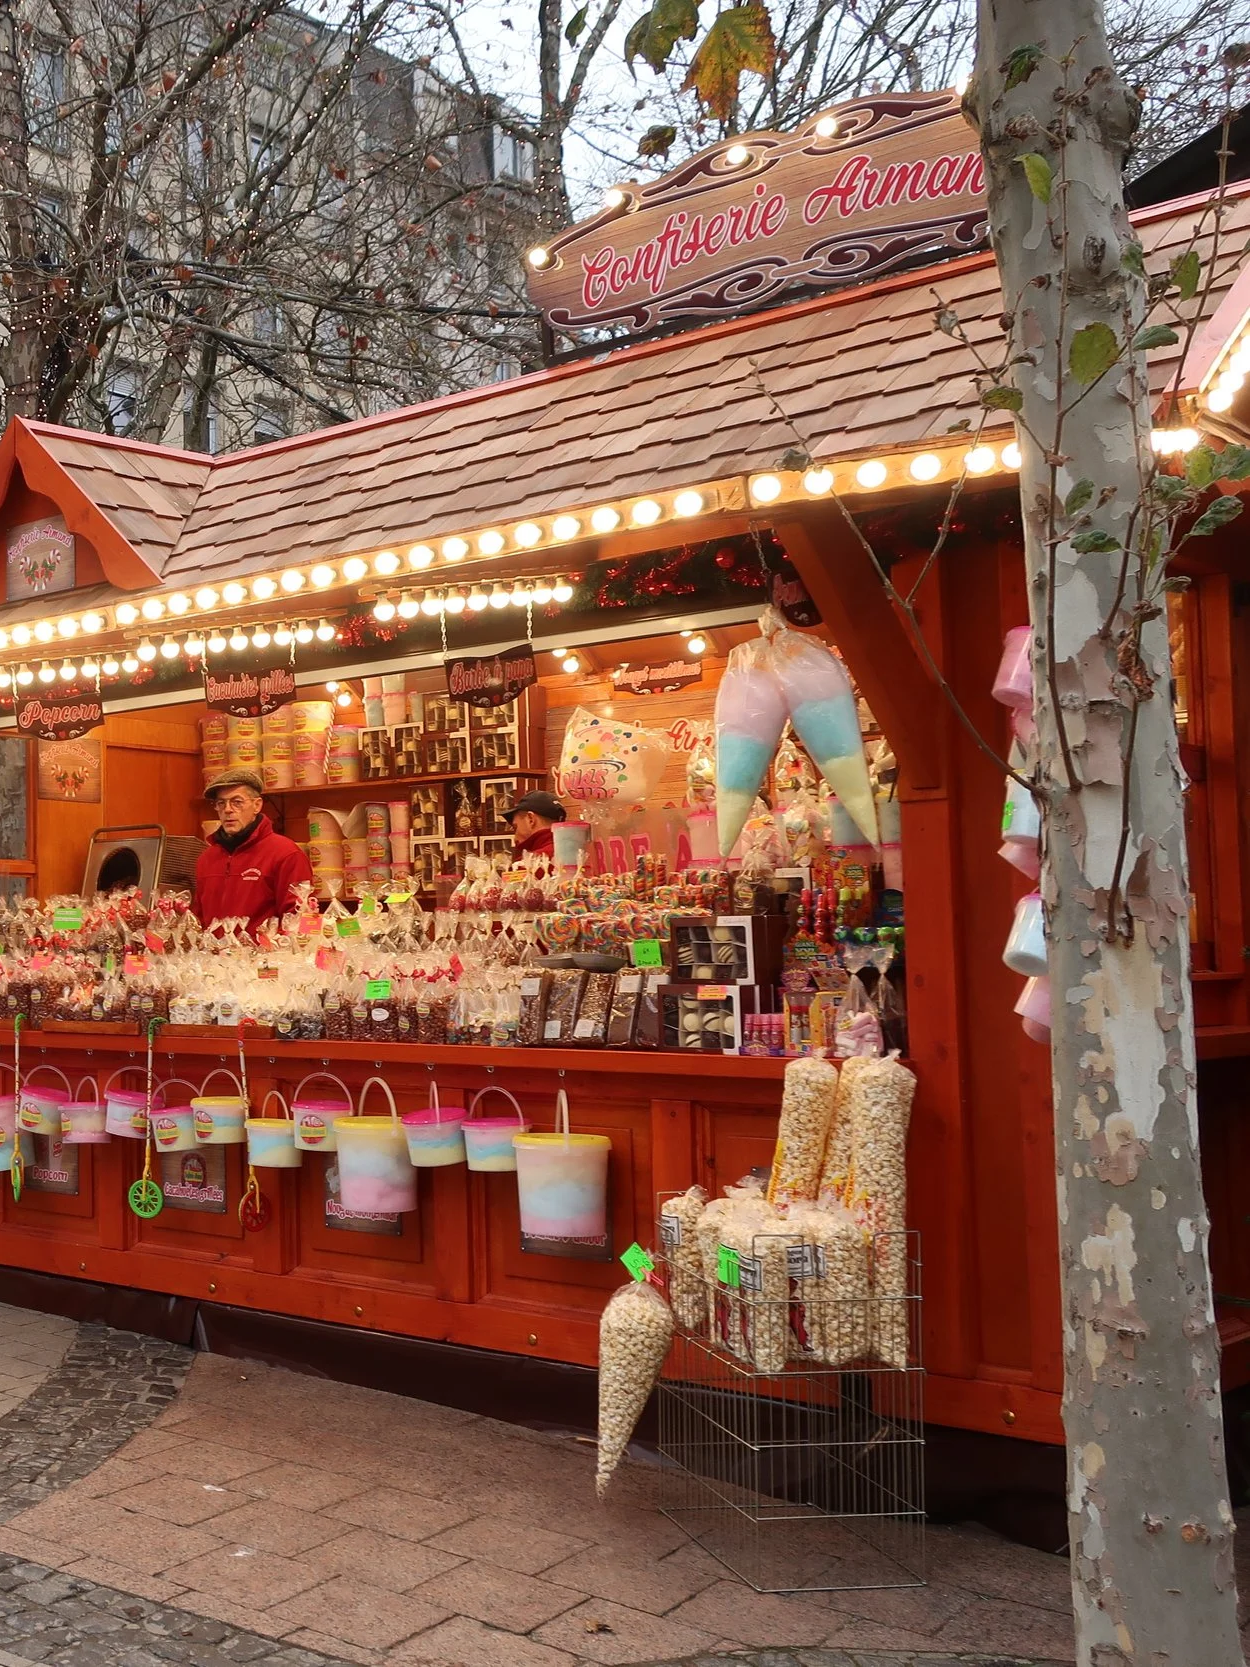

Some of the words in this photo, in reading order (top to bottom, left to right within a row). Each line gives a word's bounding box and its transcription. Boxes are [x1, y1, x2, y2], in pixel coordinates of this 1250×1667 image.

[581, 183, 789, 309] Confiserie
[803, 150, 987, 225] Arman
[41, 524, 74, 548] Armand
[450, 659, 491, 696] Barbe
[18, 700, 101, 731] Popcorn
[71, 743, 100, 770] Armand
[32, 1165, 69, 1183] Popcorn
